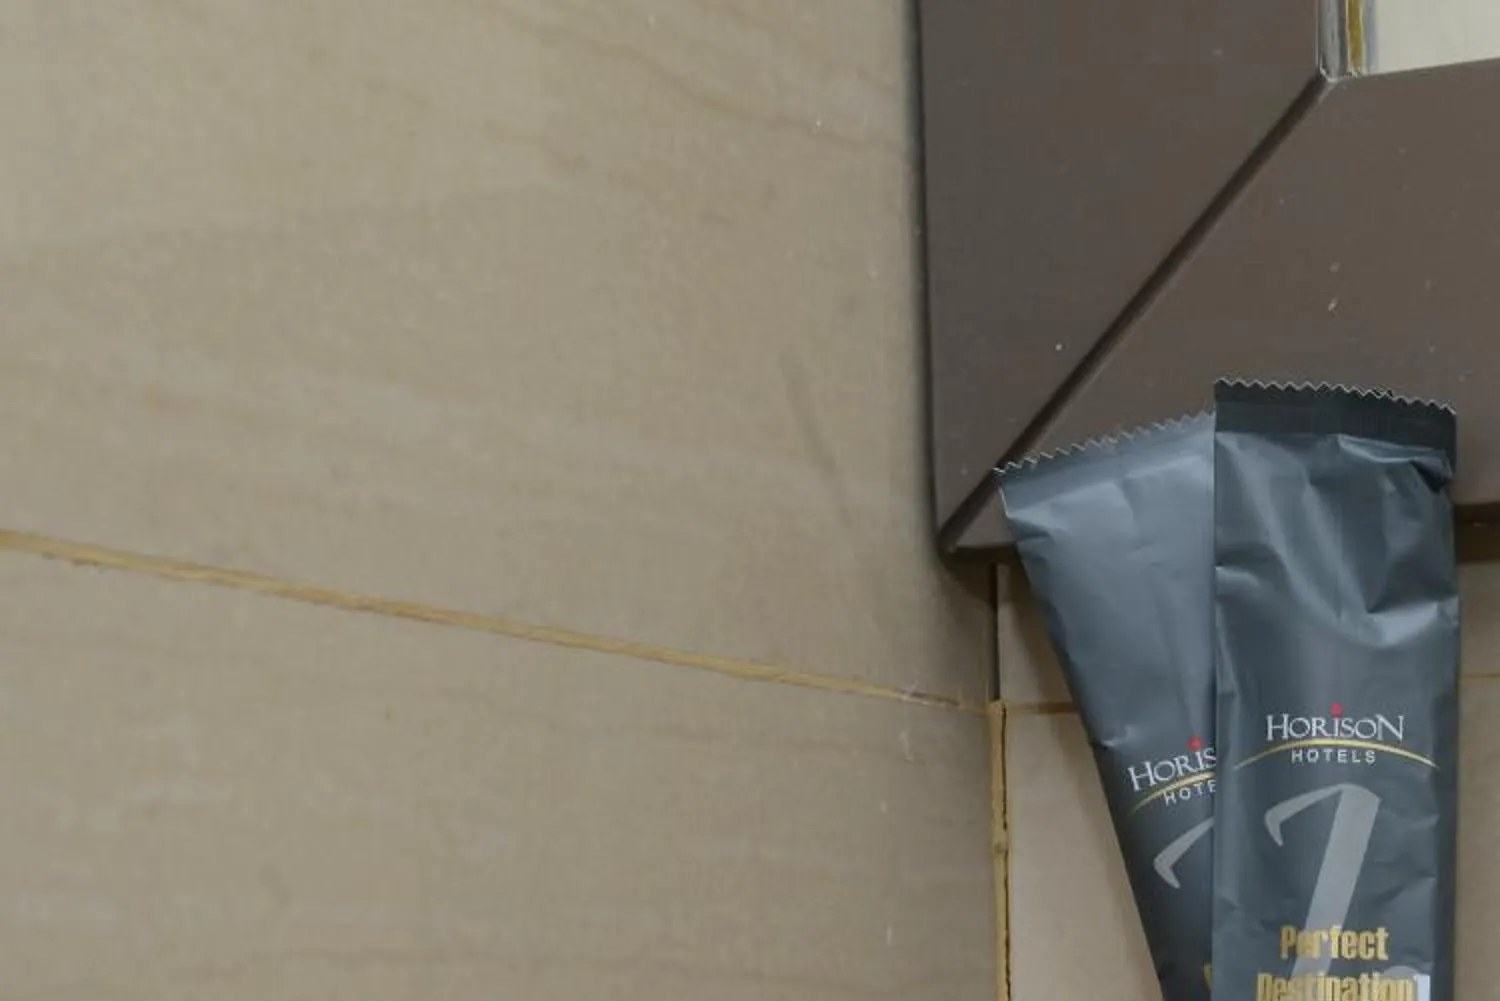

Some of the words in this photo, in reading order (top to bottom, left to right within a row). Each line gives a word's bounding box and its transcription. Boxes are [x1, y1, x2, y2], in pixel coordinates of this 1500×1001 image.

[1266, 705, 1405, 744] HORISON
[1127, 738, 1217, 793] HORIS
[1290, 748, 1377, 765] HOTELS
[1163, 779, 1217, 807] HOTE
[1279, 925, 1390, 961] Perfect
